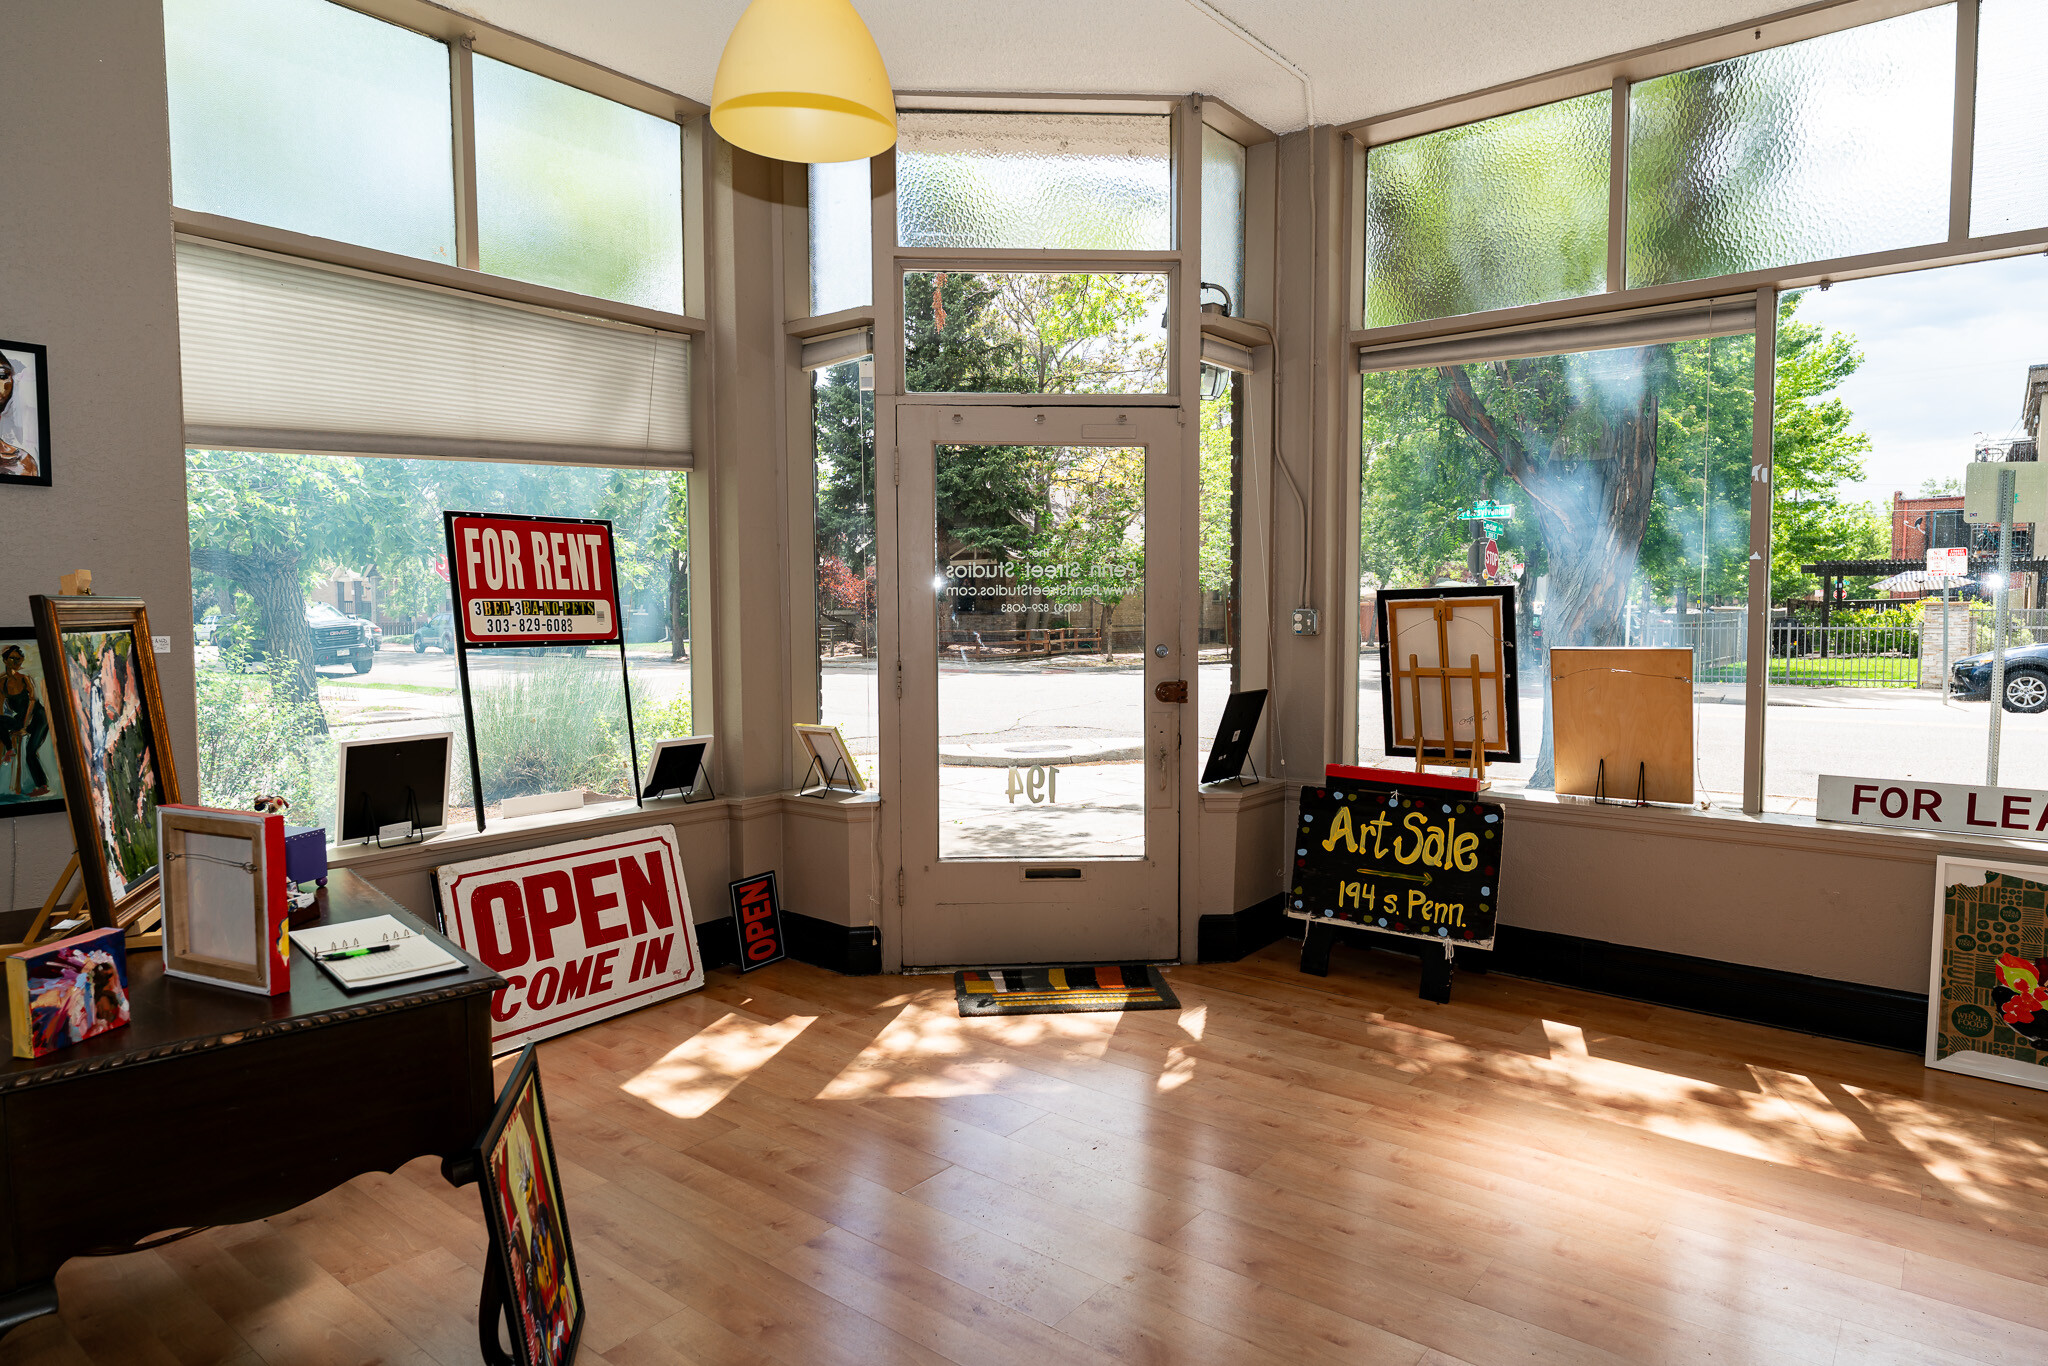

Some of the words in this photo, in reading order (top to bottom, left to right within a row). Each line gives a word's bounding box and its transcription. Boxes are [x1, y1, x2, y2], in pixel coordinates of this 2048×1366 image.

[464, 528, 525, 590] FOR
[531, 531, 602, 591] RENT
[1486, 551, 1498, 566] STOP
[487, 618, 573, 632] 303-829-6083
[1852, 784, 1942, 823] FOR
[1321, 806, 1393, 859] Art
[1393, 812, 1479, 872] Sale
[470, 850, 673, 973] OPEN
[739, 880, 776, 960] OPEN
[1338, 880, 1375, 910] 194
[1408, 889, 1466, 927] Penn.
[490, 947, 620, 1022] COME
[628, 932, 675, 984] IN
[1956, 1011, 1989, 1022] WHOLE
[1957, 1018, 1988, 1029] FOODS
